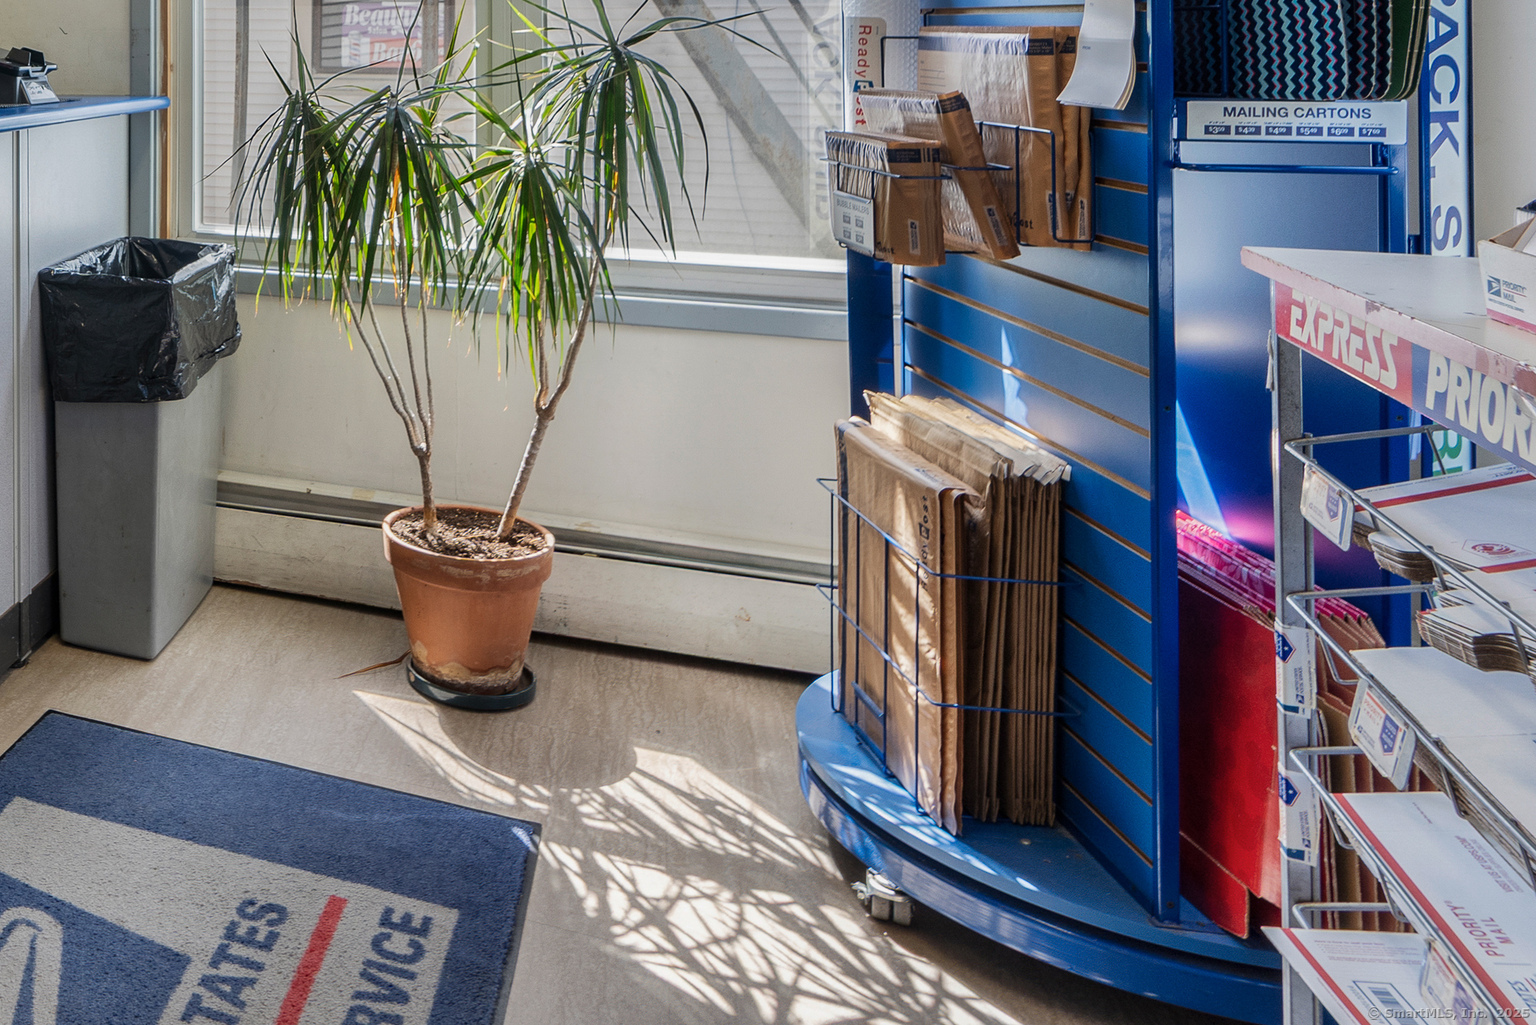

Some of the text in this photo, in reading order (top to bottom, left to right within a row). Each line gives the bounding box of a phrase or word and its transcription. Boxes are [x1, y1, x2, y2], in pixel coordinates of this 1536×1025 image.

[1223, 106, 1372, 119] MAILING CARTONS
[1431, 205, 1462, 252] S
[1502, 280, 1527, 295] PRIORITY
[1289, 288, 1399, 390] EXPRESS
[1447, 905, 1505, 957] PRIORITY
[1481, 917, 1514, 945] MAIL
[180, 898, 289, 1025] TATES
